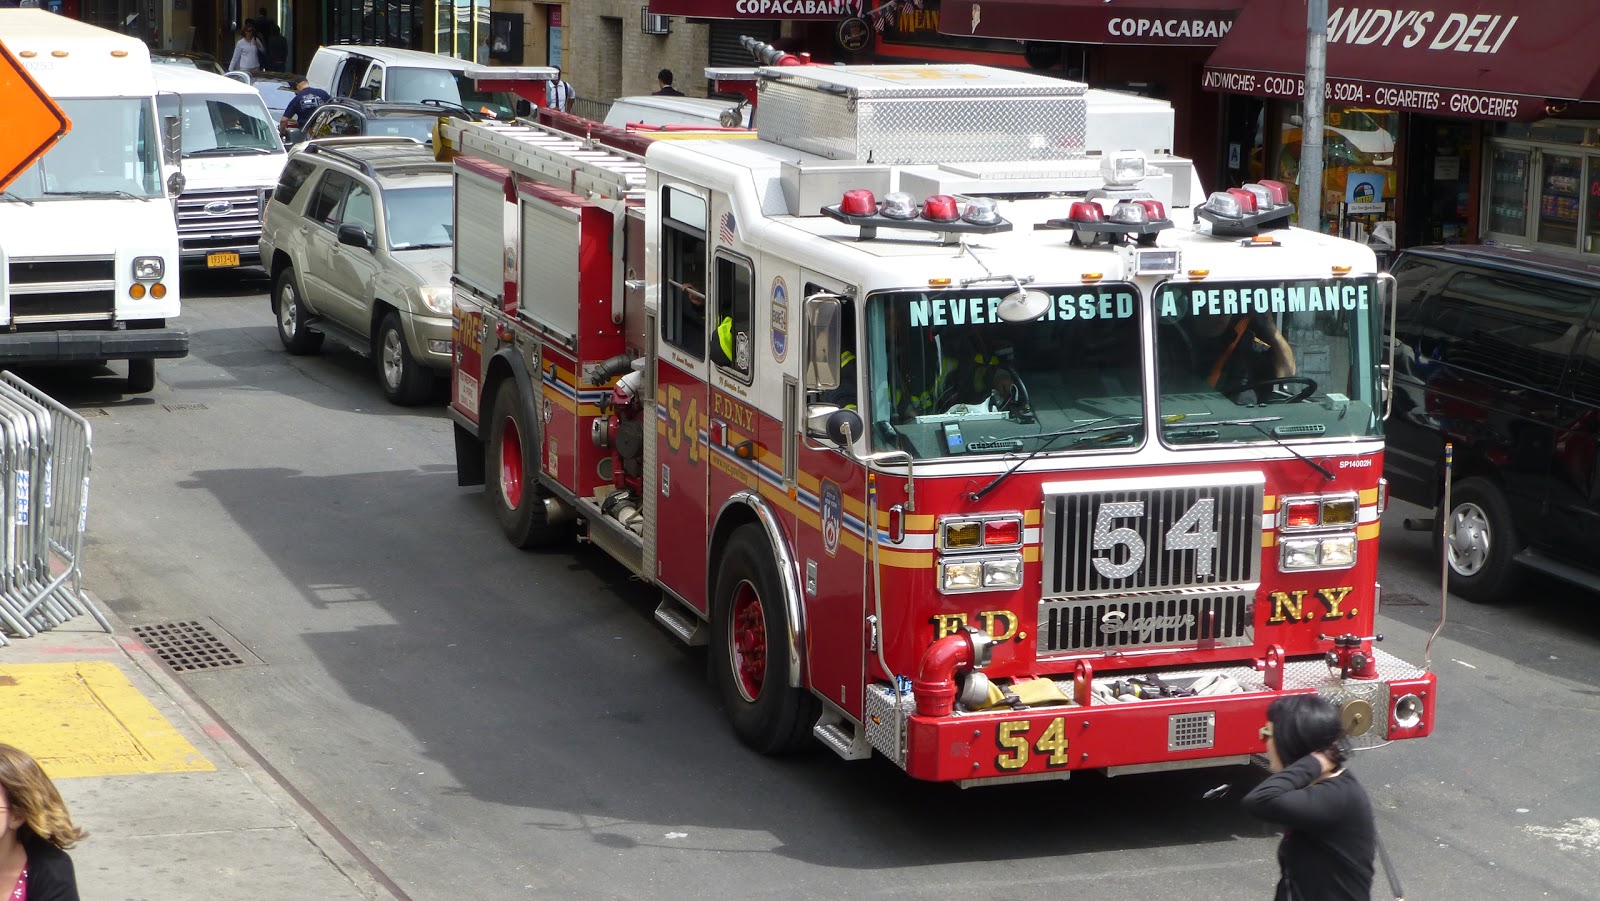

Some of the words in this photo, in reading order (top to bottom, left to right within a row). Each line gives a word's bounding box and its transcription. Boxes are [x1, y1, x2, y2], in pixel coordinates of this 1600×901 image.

[899, 9, 939, 33] MEAN
[1326, 7, 1435, 49] ANDY'S
[1429, 13, 1519, 54] DELI
[22, 62, 54, 71] 0253
[1202, 71, 1256, 92] NDWICHES
[1264, 77, 1295, 96] COLD
[1325, 82, 1332, 99] &
[1334, 82, 1364, 103] SODA
[1374, 87, 1440, 110] CIGARETTES
[1449, 94, 1519, 118] GROCERIES
[1231, 147, 1238, 162] A
[909, 296, 1004, 327] NEVER
[1037, 292, 1133, 323] ISSED
[1161, 291, 1178, 317] A
[1191, 285, 1369, 316] PERFORMANCE
[460, 309, 479, 353] FIRE
[667, 383, 699, 464] 54
[714, 392, 755, 433] F.D.N.Y.
[1339, 459, 1372, 469] SP14002H
[1092, 498, 1218, 580] 54
[931, 610, 1027, 642] FD.
[1099, 610, 1196, 640] Seagrave
[996, 716, 1069, 770] 54
